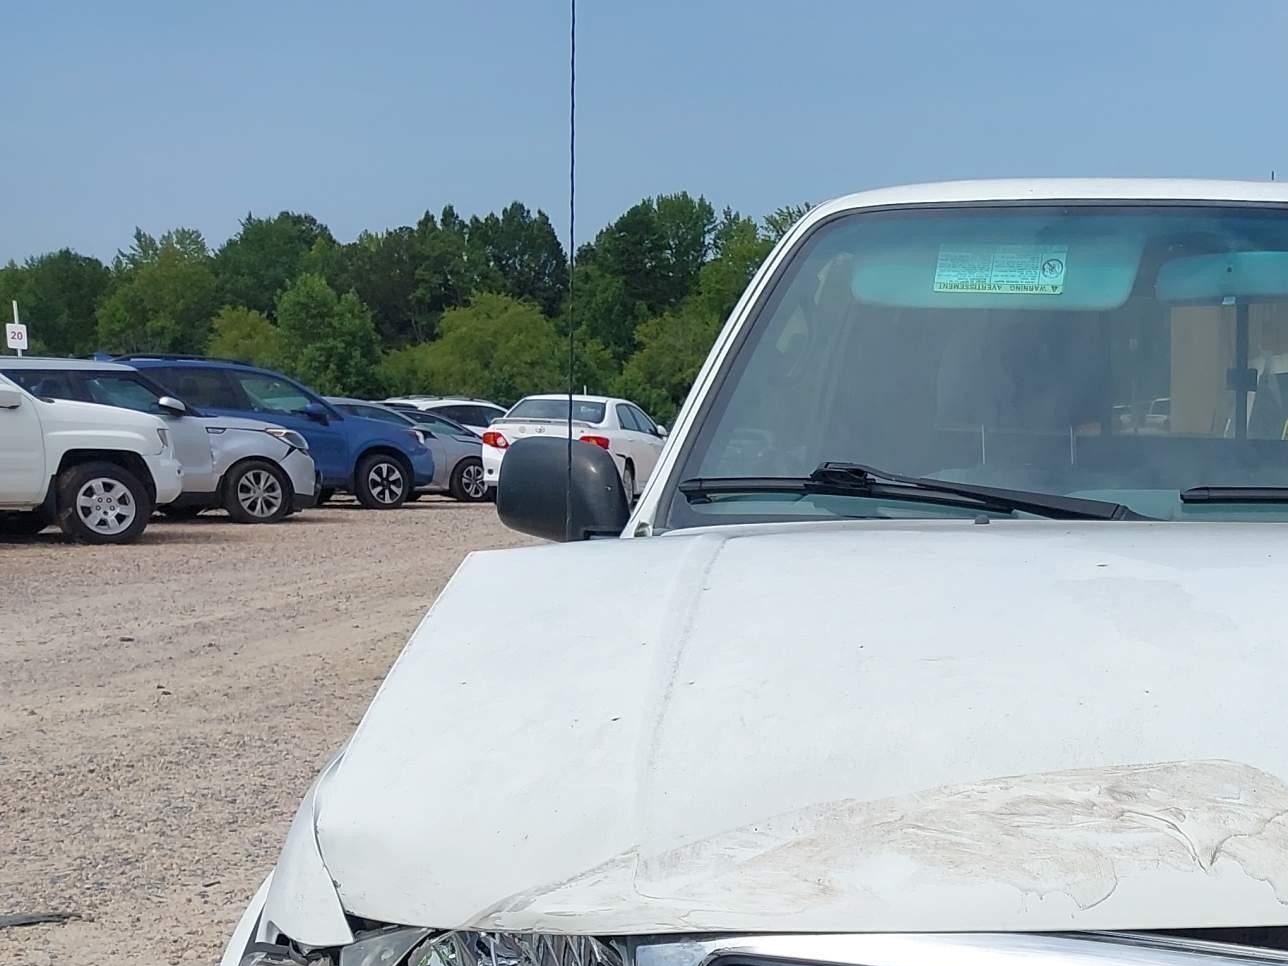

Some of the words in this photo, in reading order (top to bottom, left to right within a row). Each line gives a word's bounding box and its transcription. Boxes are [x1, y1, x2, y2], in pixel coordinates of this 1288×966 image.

[938, 282, 1002, 291] AVERTISSEMENT
[1009, 284, 1046, 292] WARNING
[10, 331, 23, 340] 20
